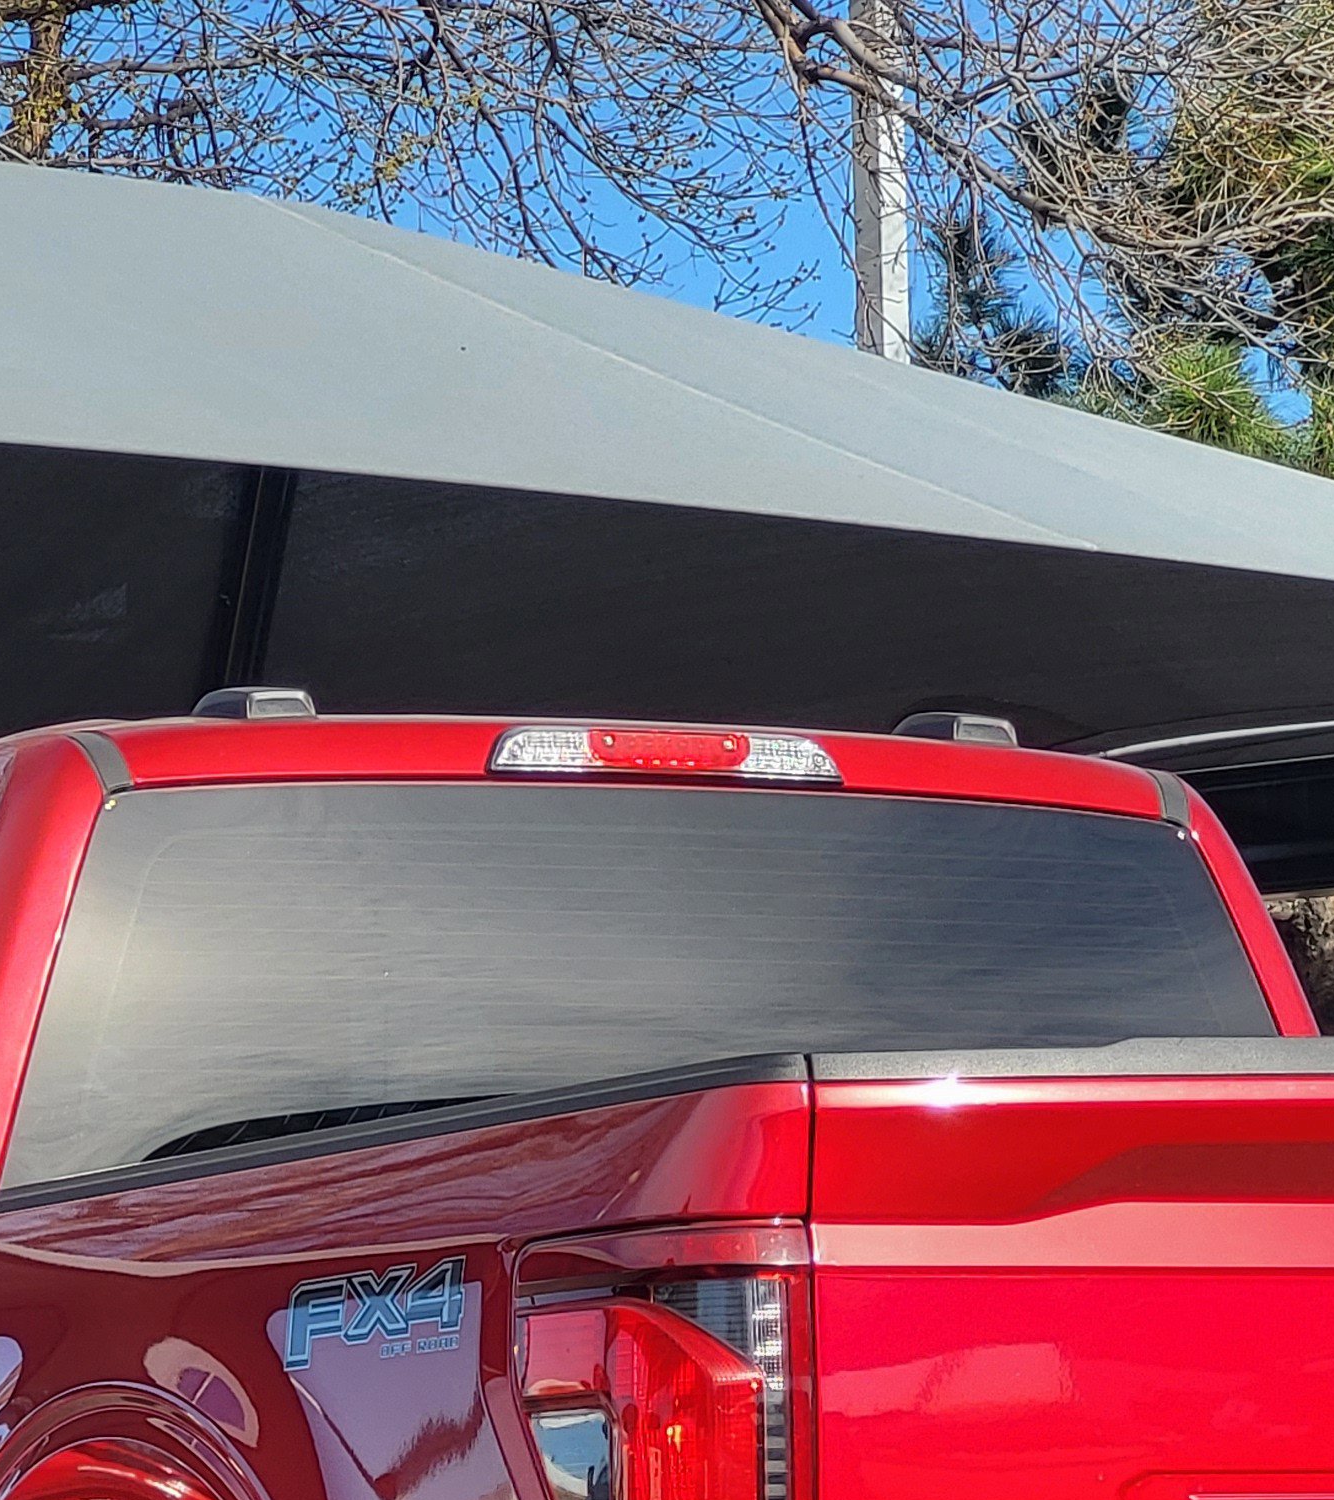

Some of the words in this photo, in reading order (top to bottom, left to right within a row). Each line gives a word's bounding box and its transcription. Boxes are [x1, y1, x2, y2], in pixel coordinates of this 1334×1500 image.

[284, 1255, 466, 1372] FX4
[380, 1341, 412, 1358] OFF
[416, 1335, 460, 1353] ROAD
